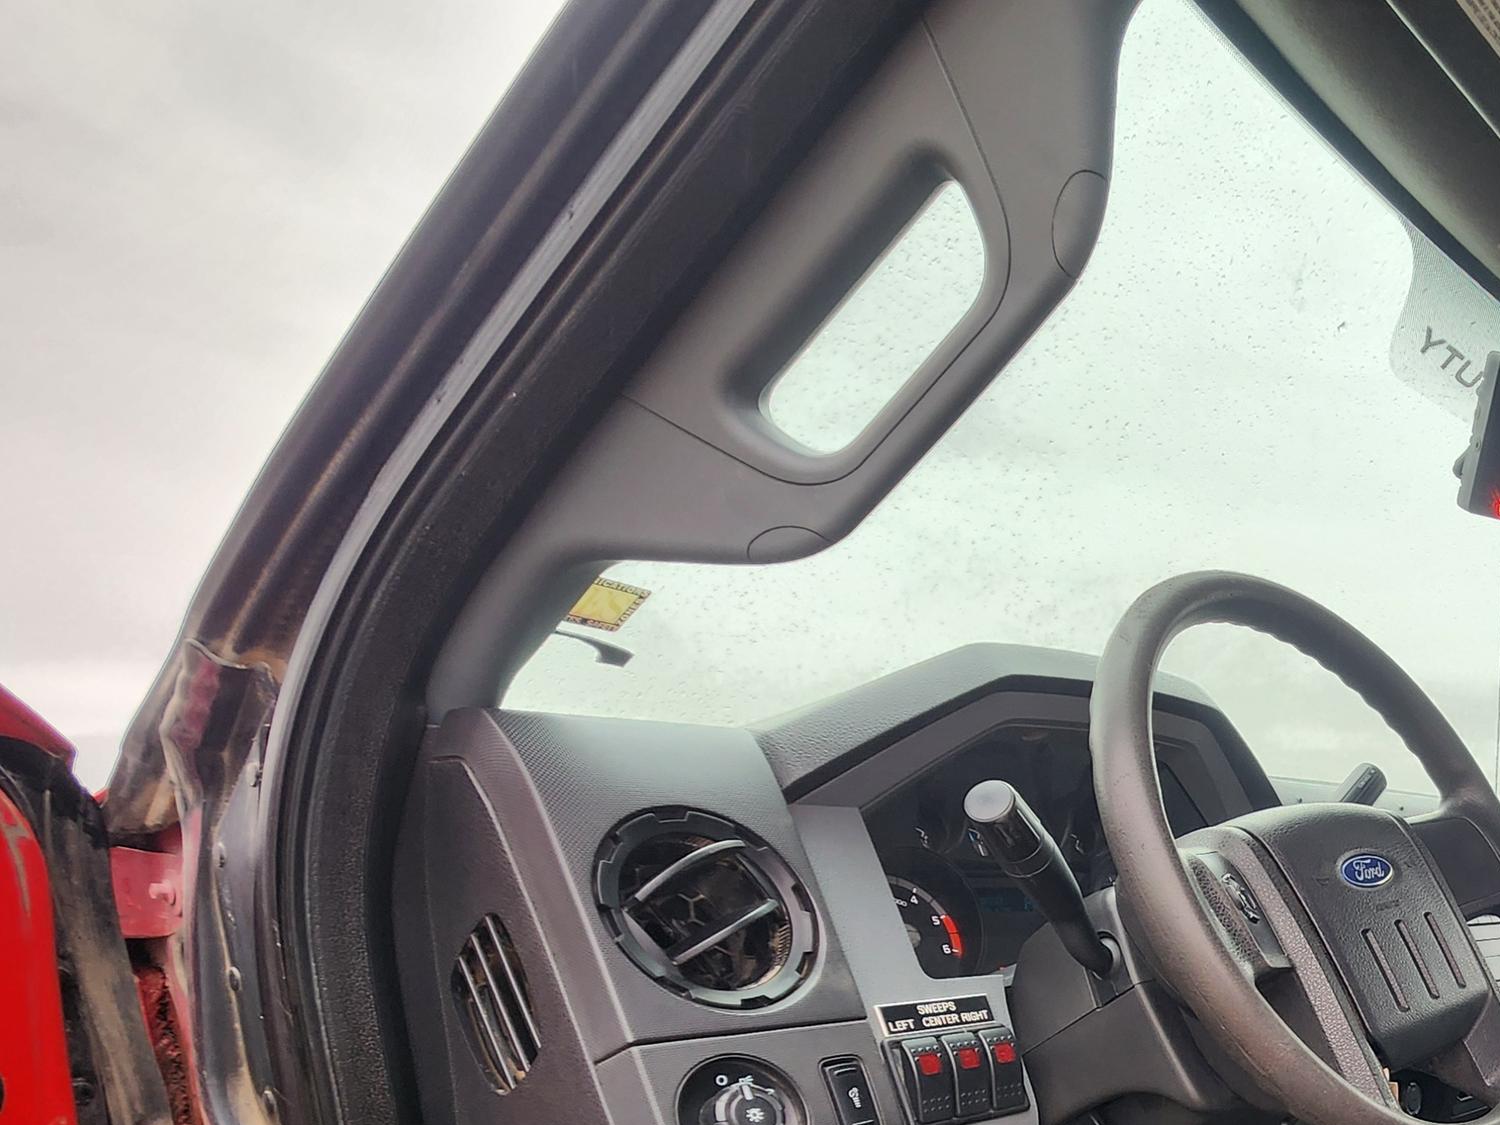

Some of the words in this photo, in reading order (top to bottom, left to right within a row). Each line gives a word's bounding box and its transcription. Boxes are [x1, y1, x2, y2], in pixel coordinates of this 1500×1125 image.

[1352, 858, 1385, 881] Ford
[910, 895, 919, 905] 4
[931, 915, 941, 926] 5
[942, 943, 952, 954] 6
[916, 1001, 957, 1015] SWEEPS
[888, 1018, 915, 1032] LEFT
[922, 1012, 960, 1027] CENTER
[960, 1009, 989, 1023] RIGHT
